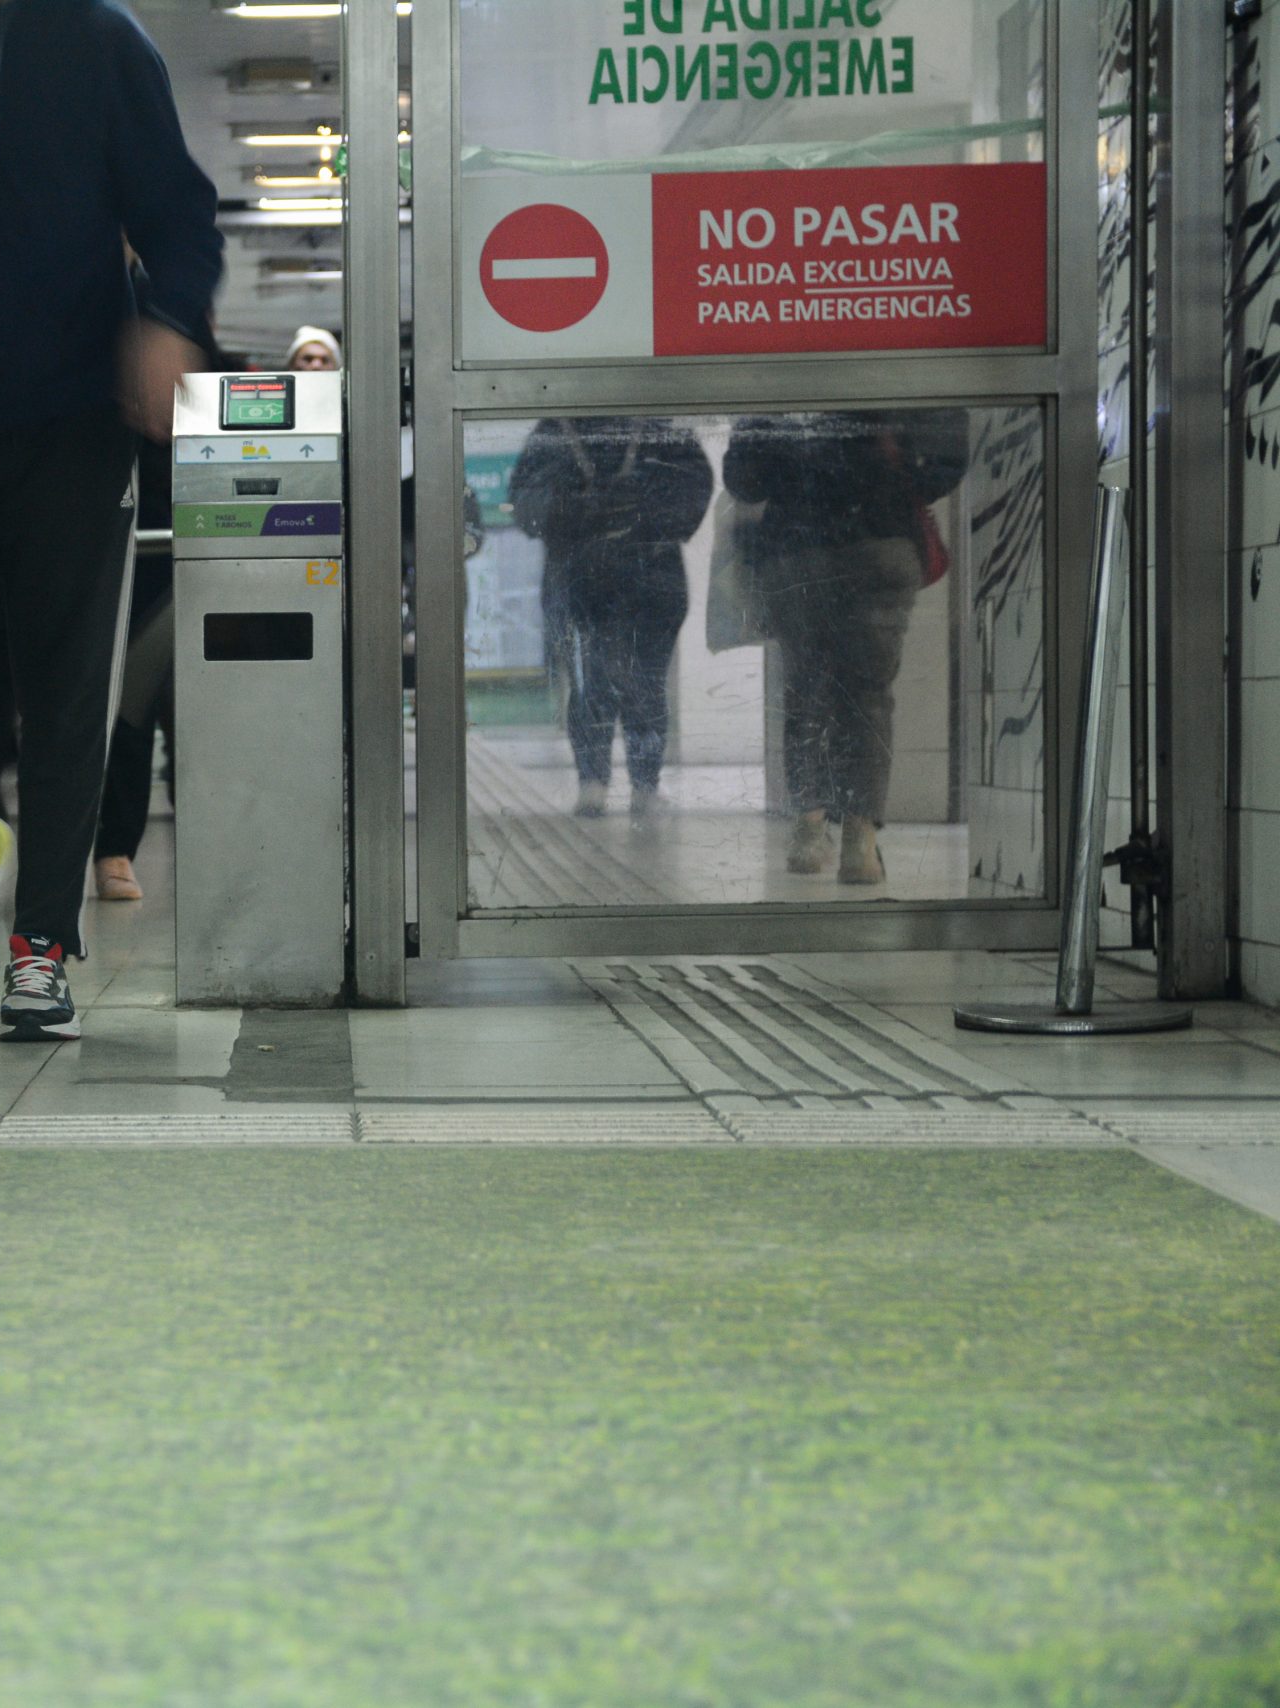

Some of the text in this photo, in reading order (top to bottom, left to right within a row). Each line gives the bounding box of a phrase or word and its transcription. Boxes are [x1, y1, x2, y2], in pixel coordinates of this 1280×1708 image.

[699, 202, 960, 249] NO PASAR
[697, 257, 953, 287] SALIDA EXCLUSIVA
[698, 294, 972, 324] PARA EMERGENCIAS
[275, 518, 305, 527] Emova
[306, 561, 339, 585] E2
